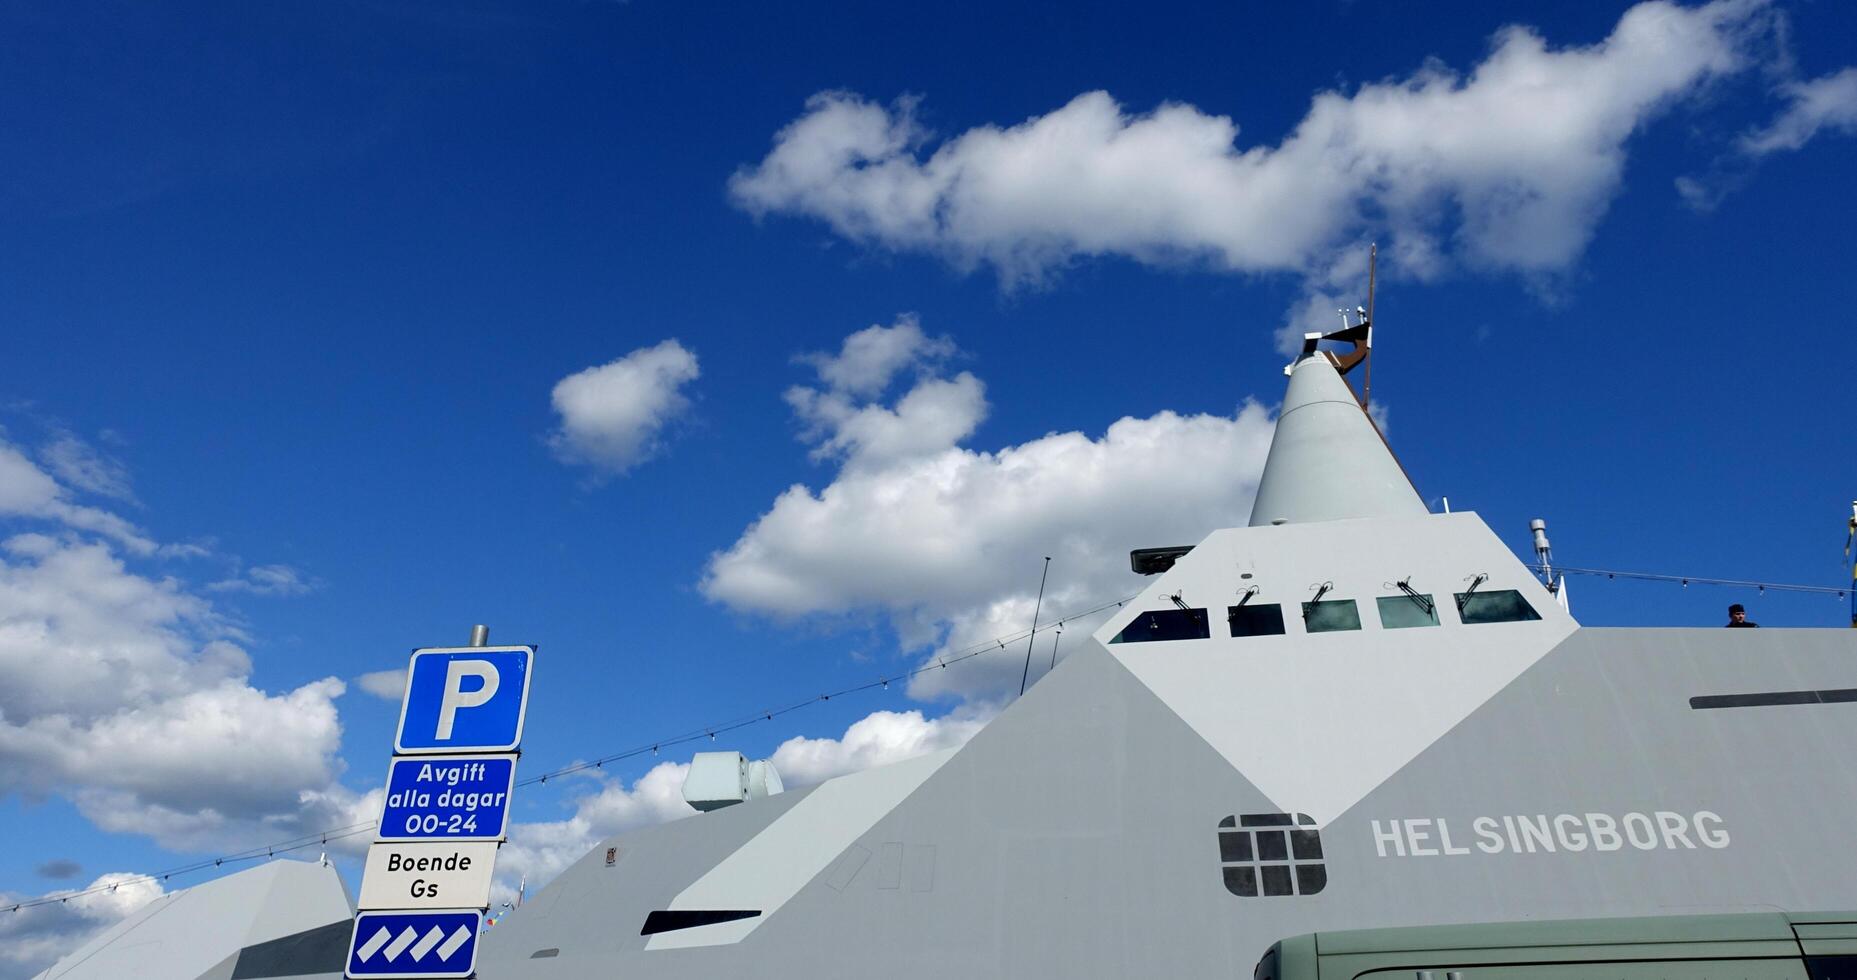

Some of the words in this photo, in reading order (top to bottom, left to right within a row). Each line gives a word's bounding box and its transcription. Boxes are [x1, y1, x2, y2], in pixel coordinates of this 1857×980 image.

[435, 660, 500, 740] P
[416, 763, 486, 786] Avgift
[388, 790, 430, 808] alla
[437, 789, 505, 811] dagar
[405, 815, 477, 834] 00-24
[1371, 811, 1731, 857] HELSINGBORG
[388, 853, 472, 872] Boende
[410, 880, 439, 898] Gs
